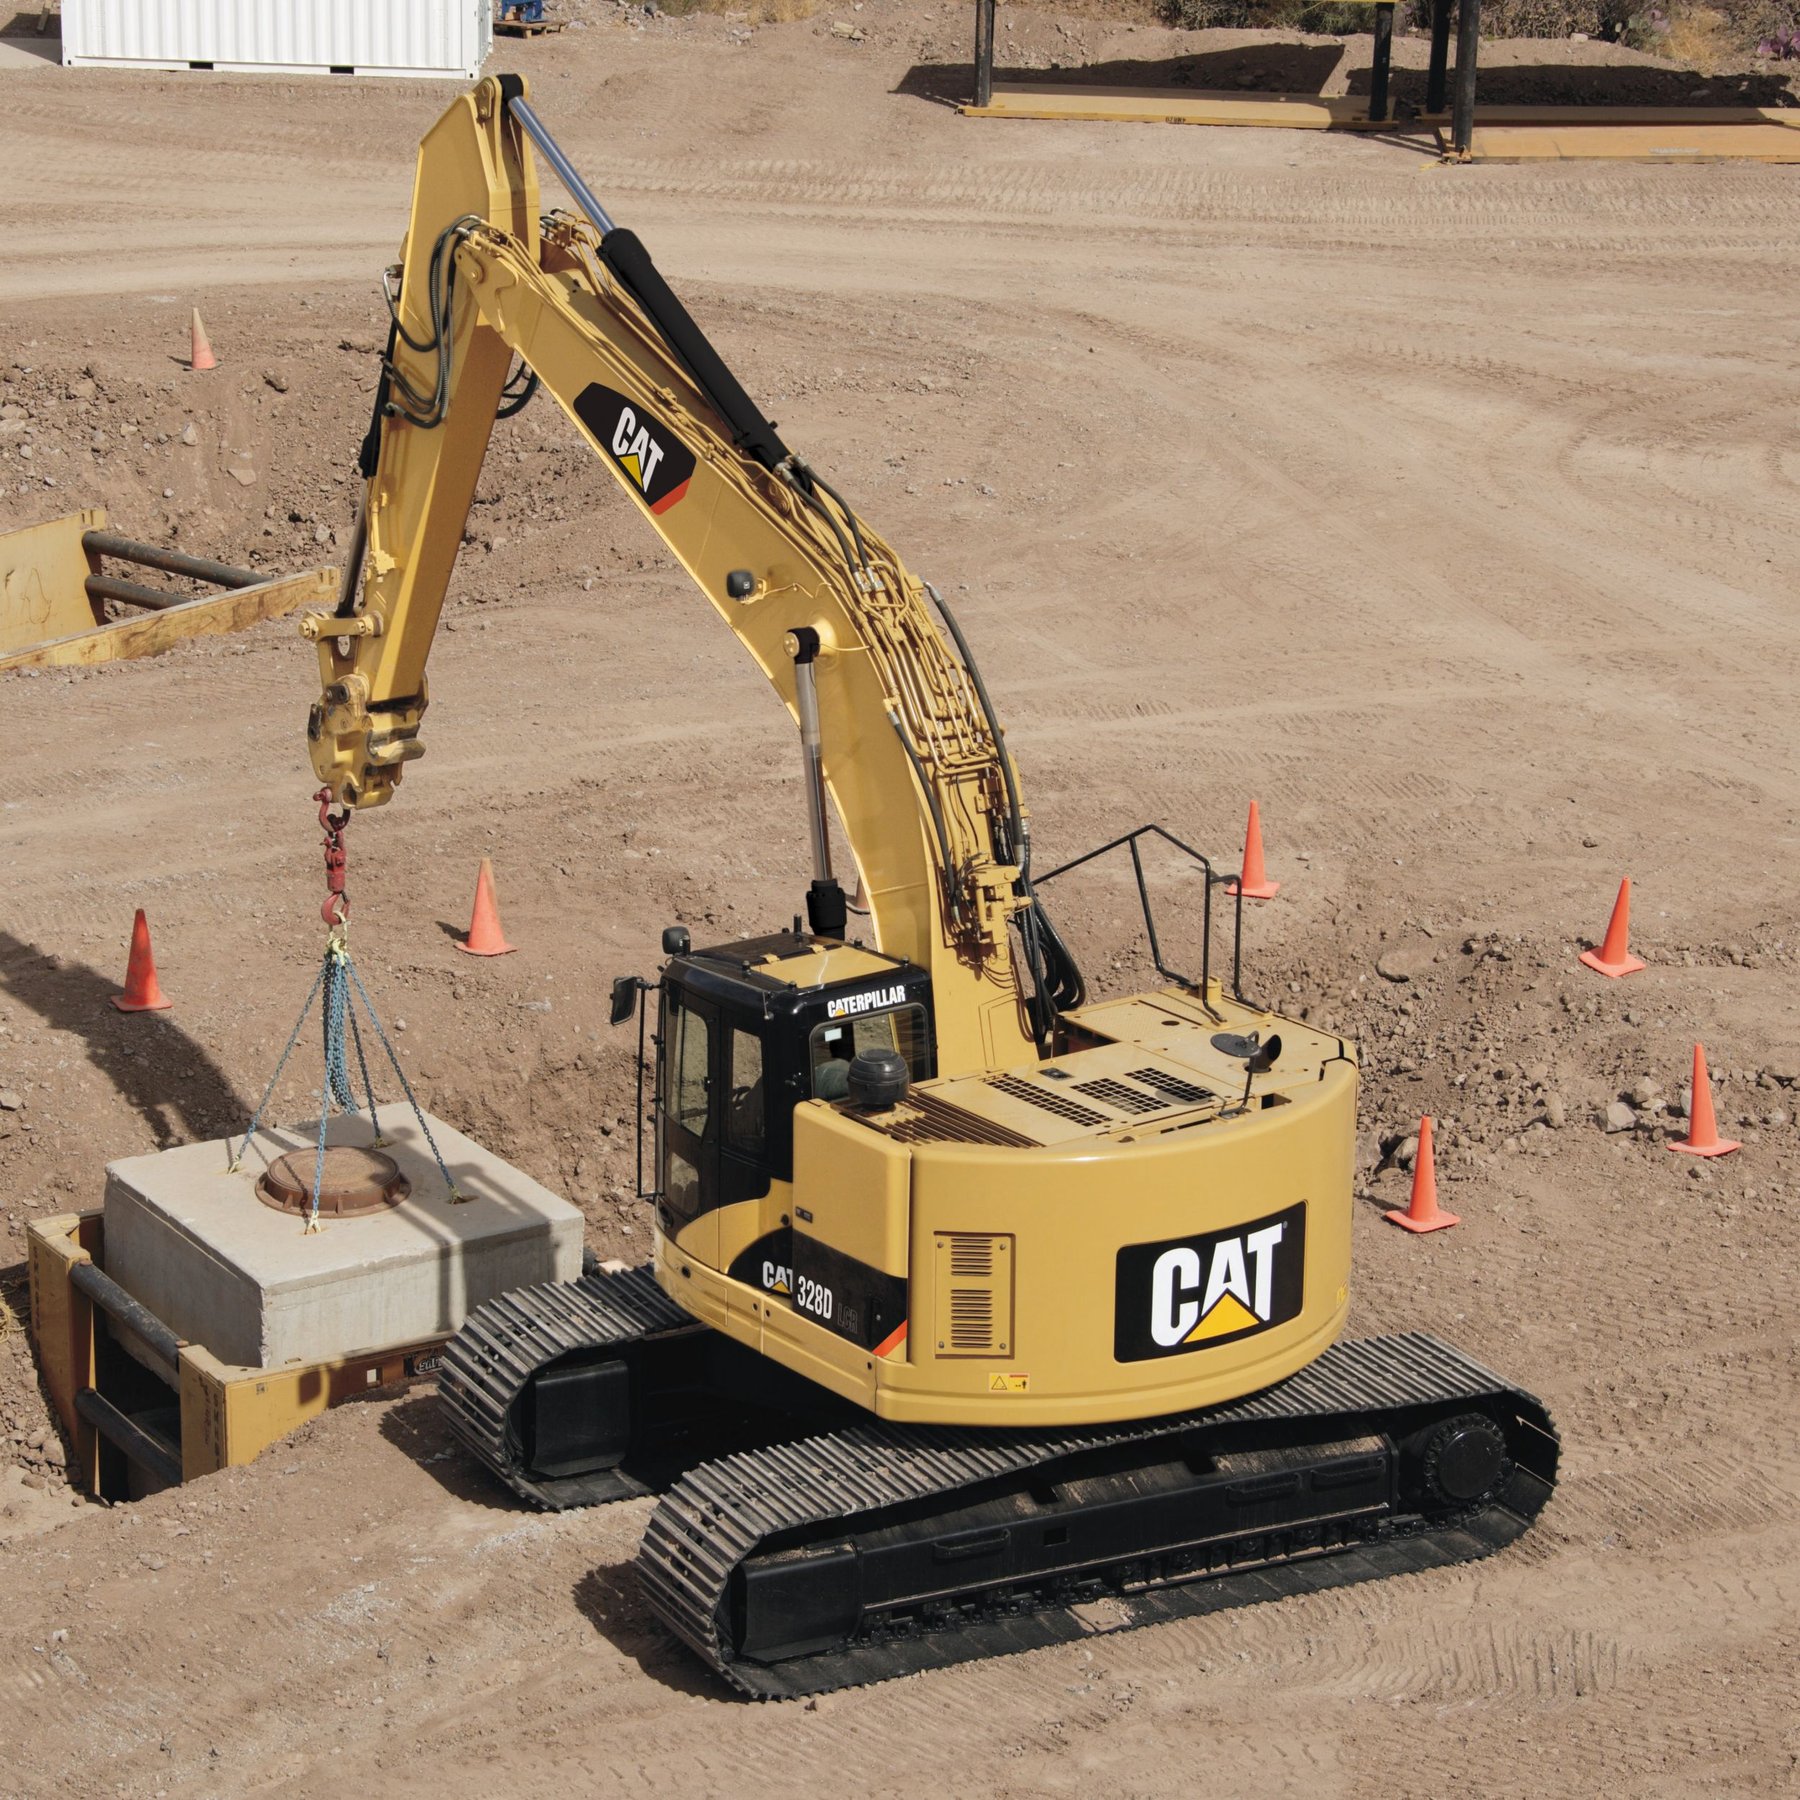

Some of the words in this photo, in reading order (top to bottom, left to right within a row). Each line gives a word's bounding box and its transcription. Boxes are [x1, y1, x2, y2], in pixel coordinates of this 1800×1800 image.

[612, 406, 664, 493] CAT
[827, 985, 906, 1018] CATERPILLAR
[762, 1261, 793, 1292] CAT
[797, 1275, 833, 1320] 328D
[837, 1303, 858, 1334] LCR
[1151, 1222, 1283, 1347] CAT
